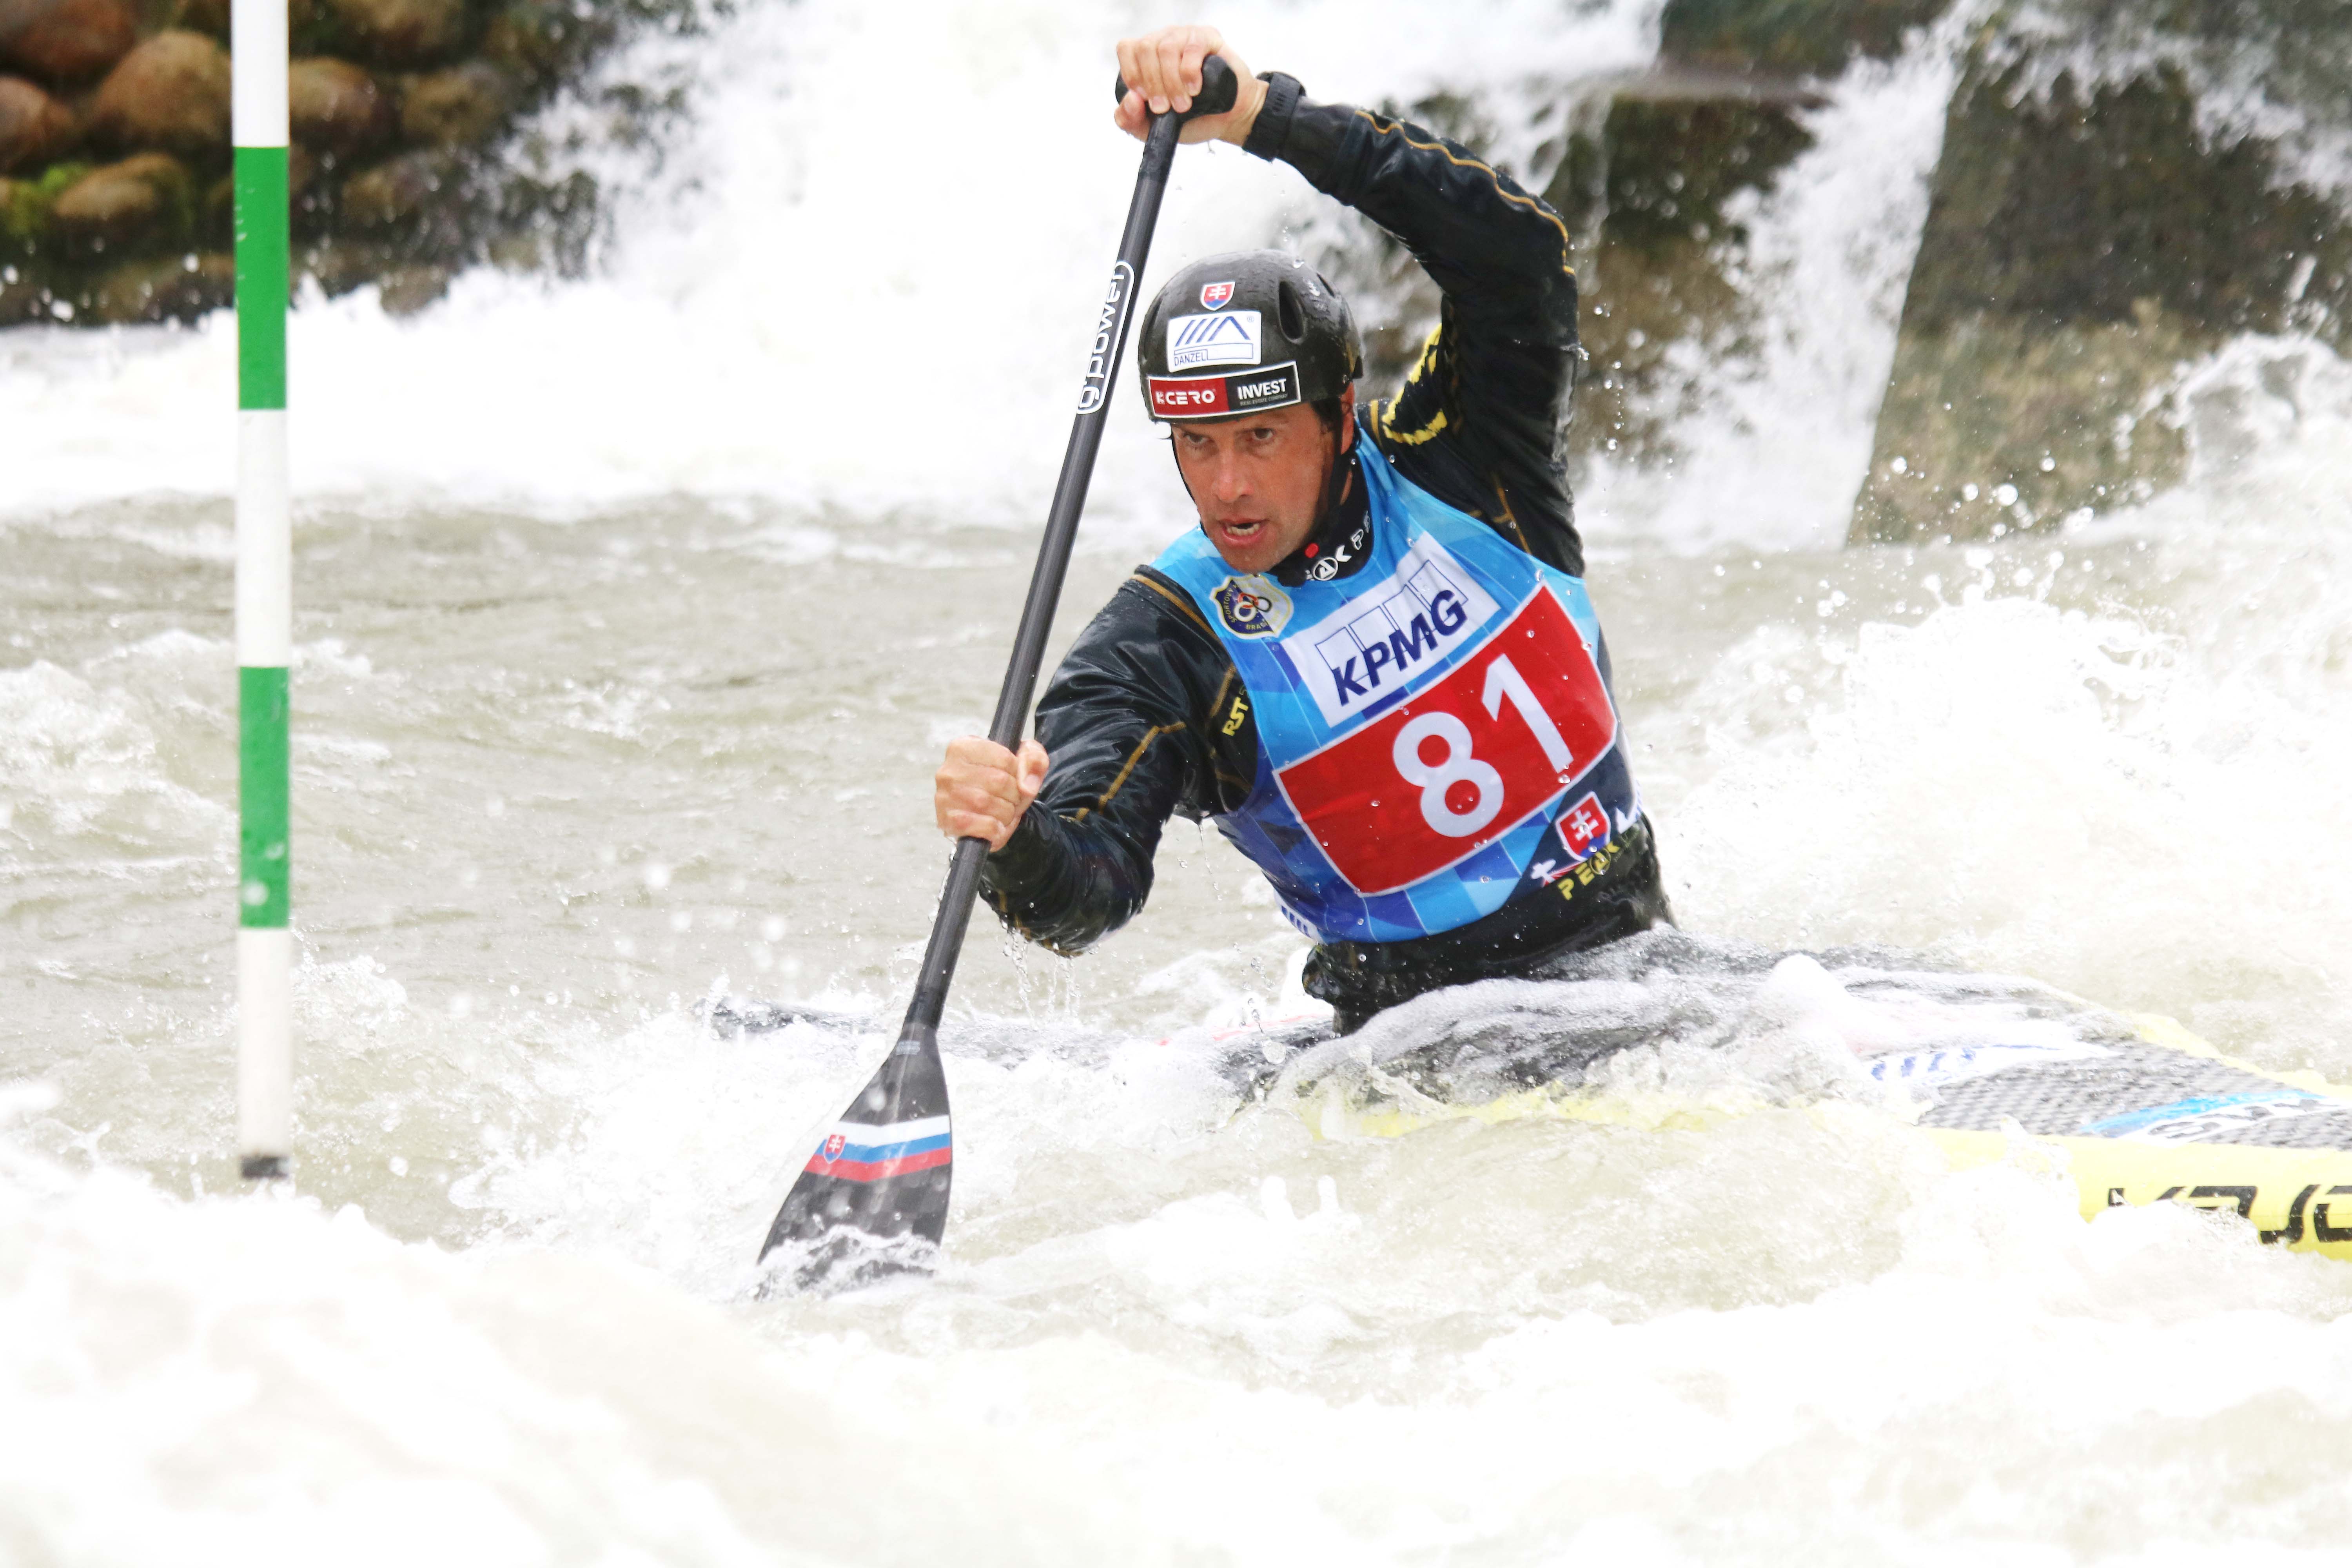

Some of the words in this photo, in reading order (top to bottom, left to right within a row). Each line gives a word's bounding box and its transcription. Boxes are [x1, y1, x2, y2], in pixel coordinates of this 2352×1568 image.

[1174, 352, 1206, 366] DANZEL
[1237, 378, 1287, 400] INVEST
[1332, 590, 1468, 707] KPMG
[1222, 696, 1249, 737] RST
[1393, 653, 1574, 838] 81
[1557, 841, 1621, 900] PEAK
